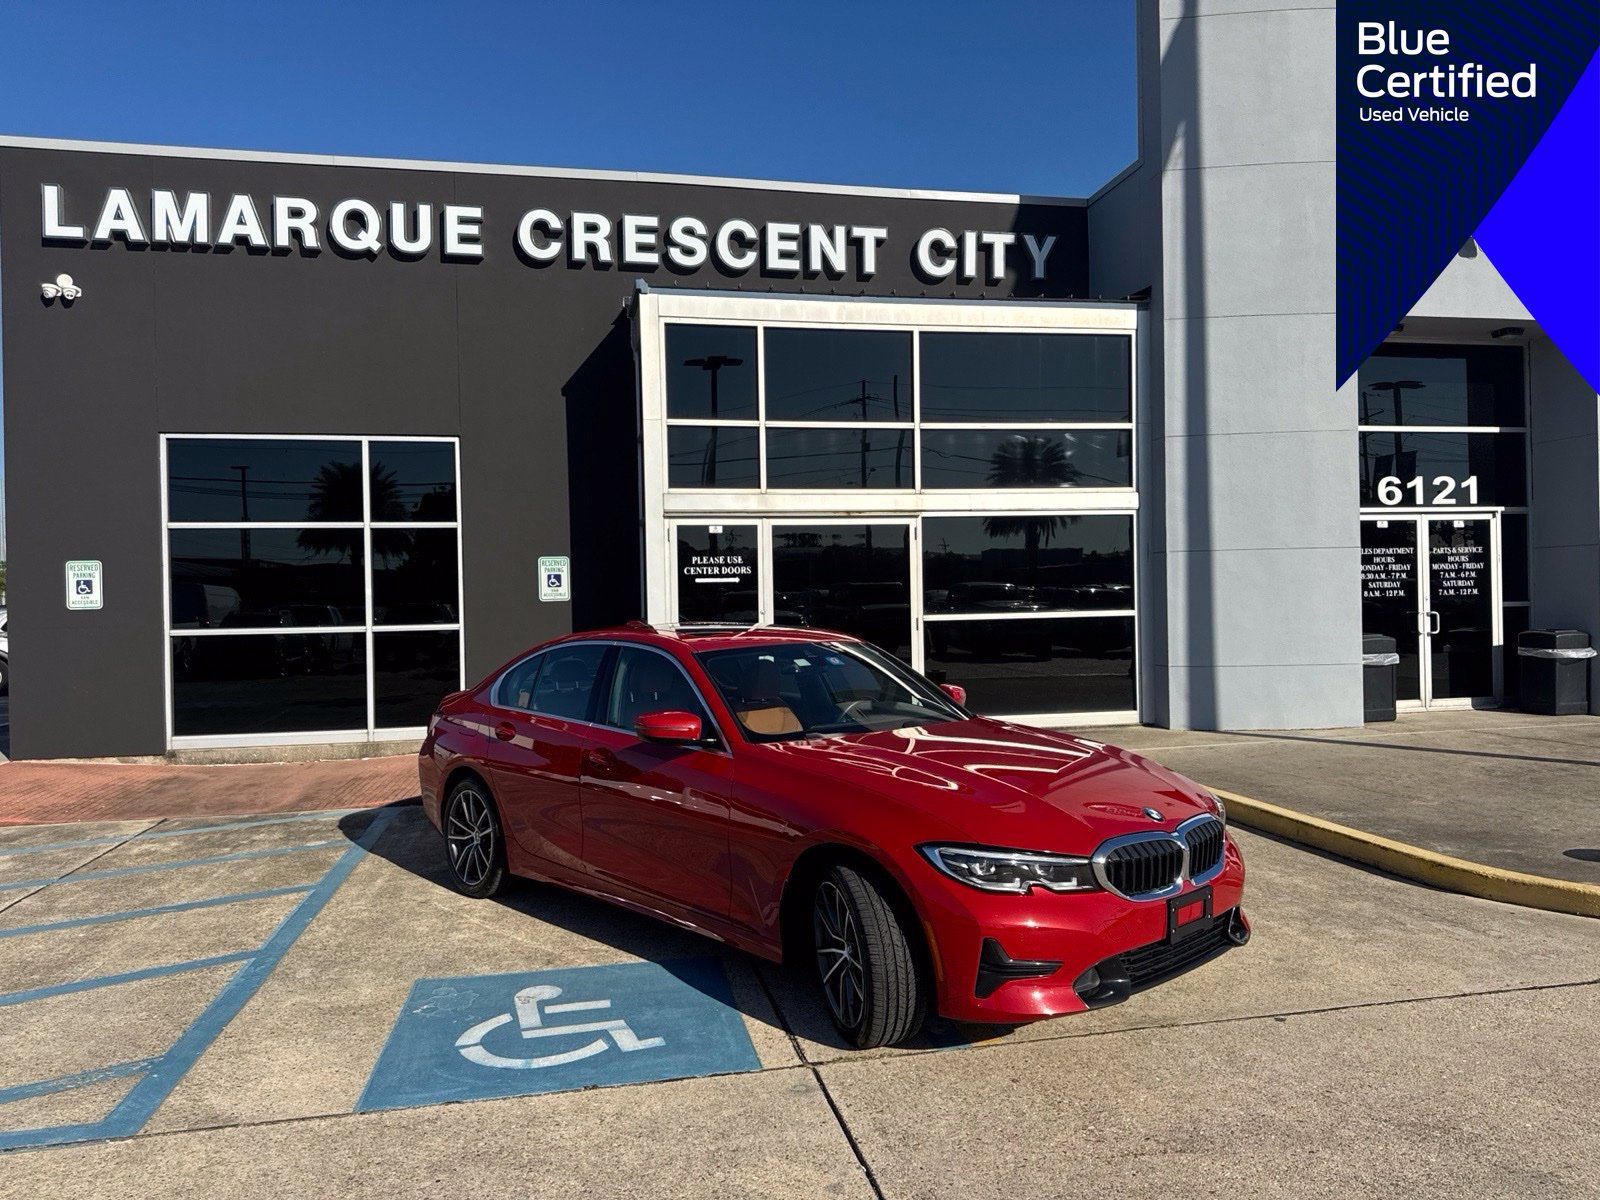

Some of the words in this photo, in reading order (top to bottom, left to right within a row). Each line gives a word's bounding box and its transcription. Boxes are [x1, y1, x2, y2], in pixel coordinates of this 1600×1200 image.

[42, 184, 483, 256] LAMARQUE
[516, 208, 889, 274] CRESCENT
[917, 227, 1057, 280] CITY
[1377, 475, 1479, 506] 6121
[1373, 547, 1414, 555] DEPARTMENT
[1457, 546, 1483, 554] SERVICE
[692, 556, 725, 565] PLEASE
[727, 555, 744, 564] USE
[69, 564, 99, 572] RESERVED
[1360, 564, 1384, 572] ONDAY
[1388, 563, 1411, 571] FRIDAY
[1432, 562, 1458, 570] MONDAY
[1462, 562, 1484, 570] FRIDAY
[684, 566, 720, 575] CENTER
[721, 566, 752, 574] DOORS
[1386, 589, 1393, 597] 12
